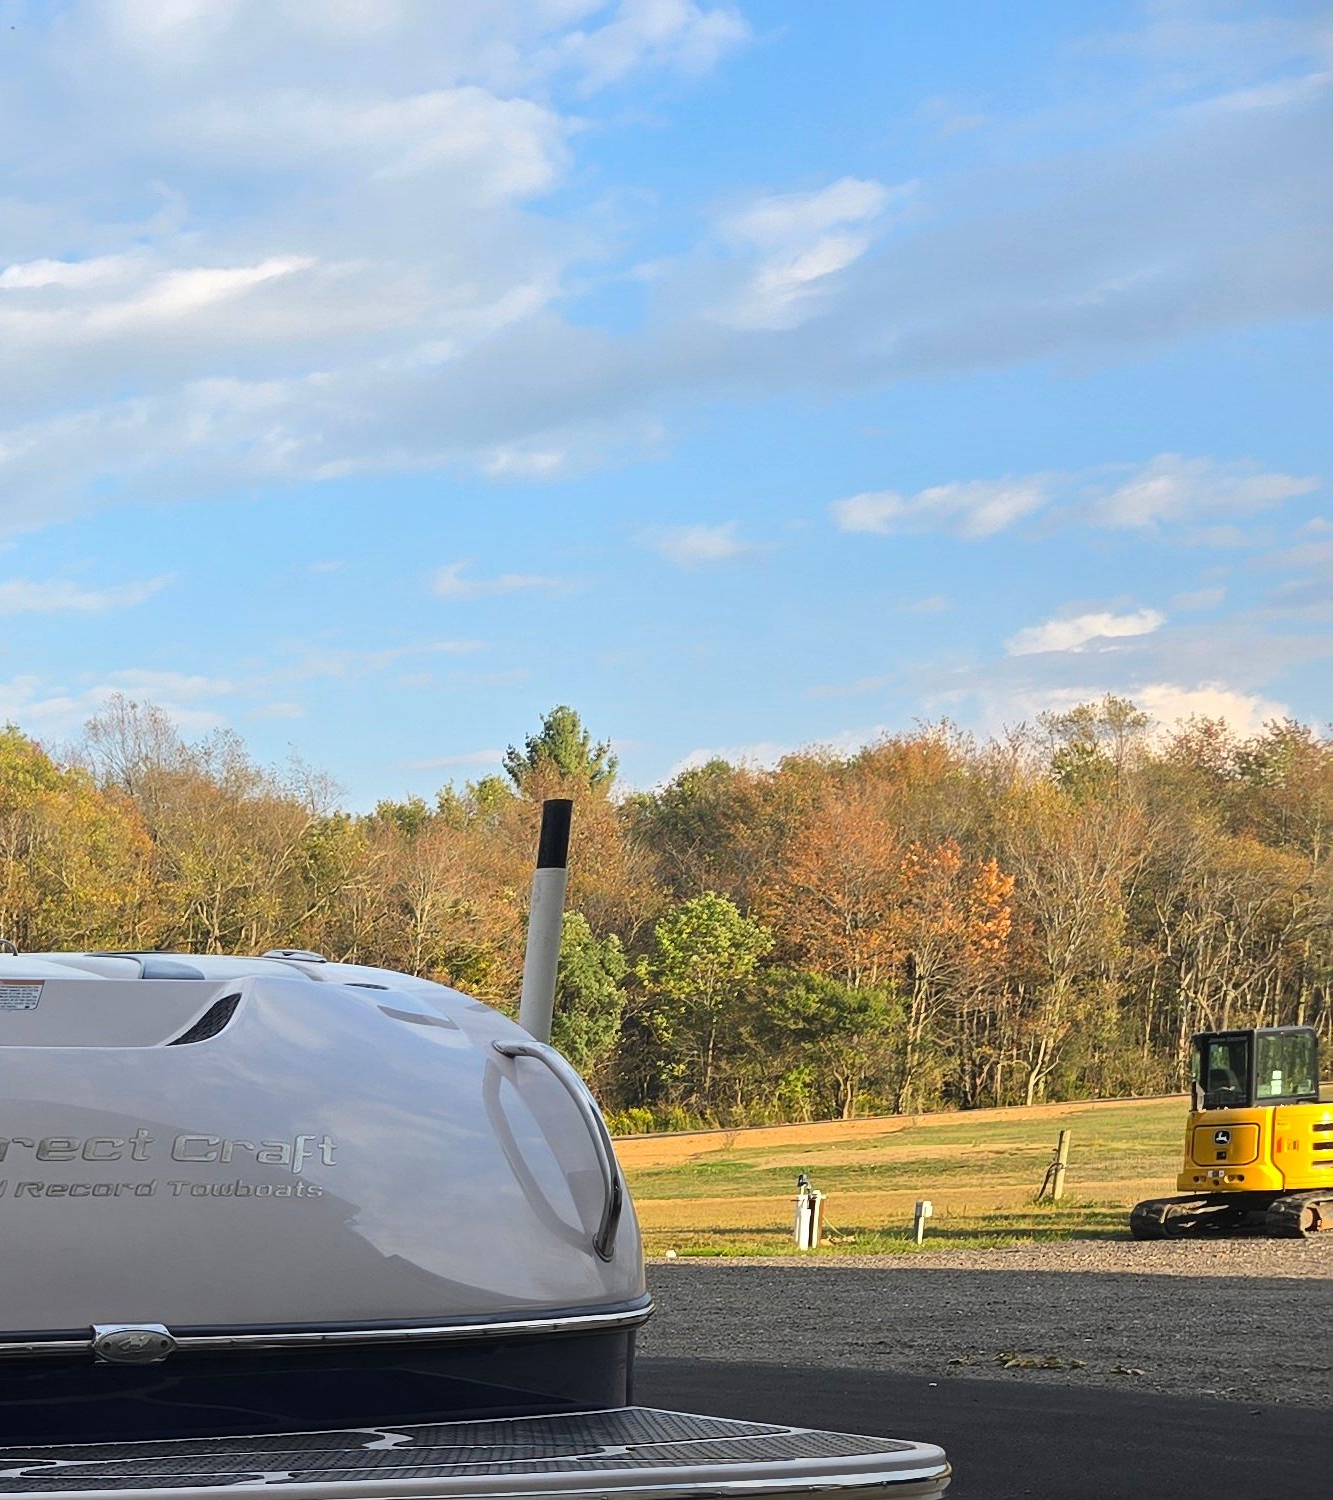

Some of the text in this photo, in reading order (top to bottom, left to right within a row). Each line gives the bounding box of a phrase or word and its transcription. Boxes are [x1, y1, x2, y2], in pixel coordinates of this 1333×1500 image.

[171, 1134, 338, 1174] Craft
[14, 1179, 158, 1199] Record
[167, 1179, 324, 1199] Towboats
